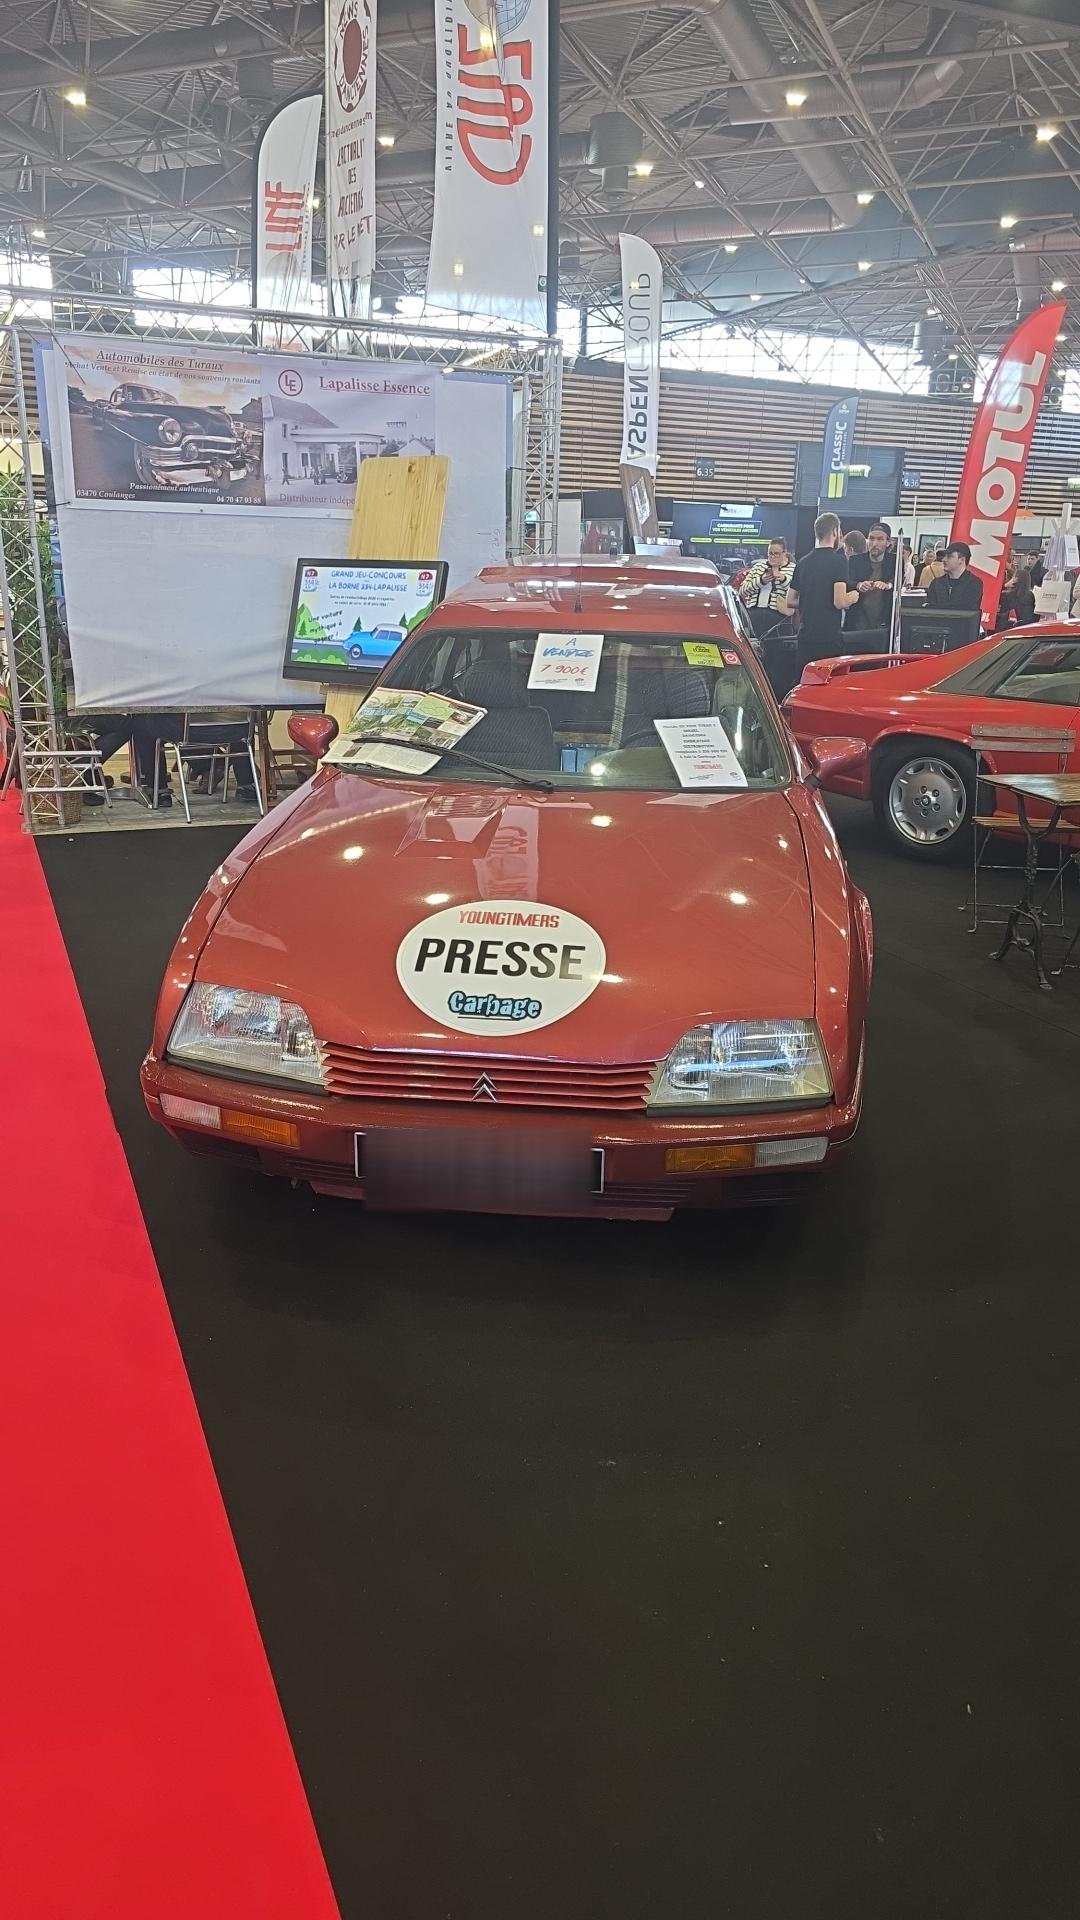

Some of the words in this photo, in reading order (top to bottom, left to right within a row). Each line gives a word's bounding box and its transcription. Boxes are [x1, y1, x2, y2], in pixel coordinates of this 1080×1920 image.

[96, 350, 165, 366] Automobiles
[167, 356, 185, 368] des
[187, 358, 224, 371] Turaux
[197, 374, 231, 382] souvenirs
[232, 376, 261, 385] roulants
[319, 376, 380, 392] Lapalisse
[383, 380, 430, 395] Essence
[831, 421, 847, 471] CLASSIC
[968, 350, 1047, 578] MOTUL
[696, 467, 714, 477] 6.35
[904, 479, 919, 487] 6.36
[76, 489, 97, 497] 03470
[98, 490, 136, 500] Coulanges
[279, 493, 327, 503] Distributeur
[331, 570, 354, 578] GRAND
[355, 571, 407, 580] JEU-CONCOURS
[338, 582, 360, 591] BORNE
[542, 647, 596, 658] VENDRE
[458, 909, 561, 928] YOUNGTIMERS
[414, 937, 587, 981] PRESSE
[447, 990, 542, 1020] Carbage
